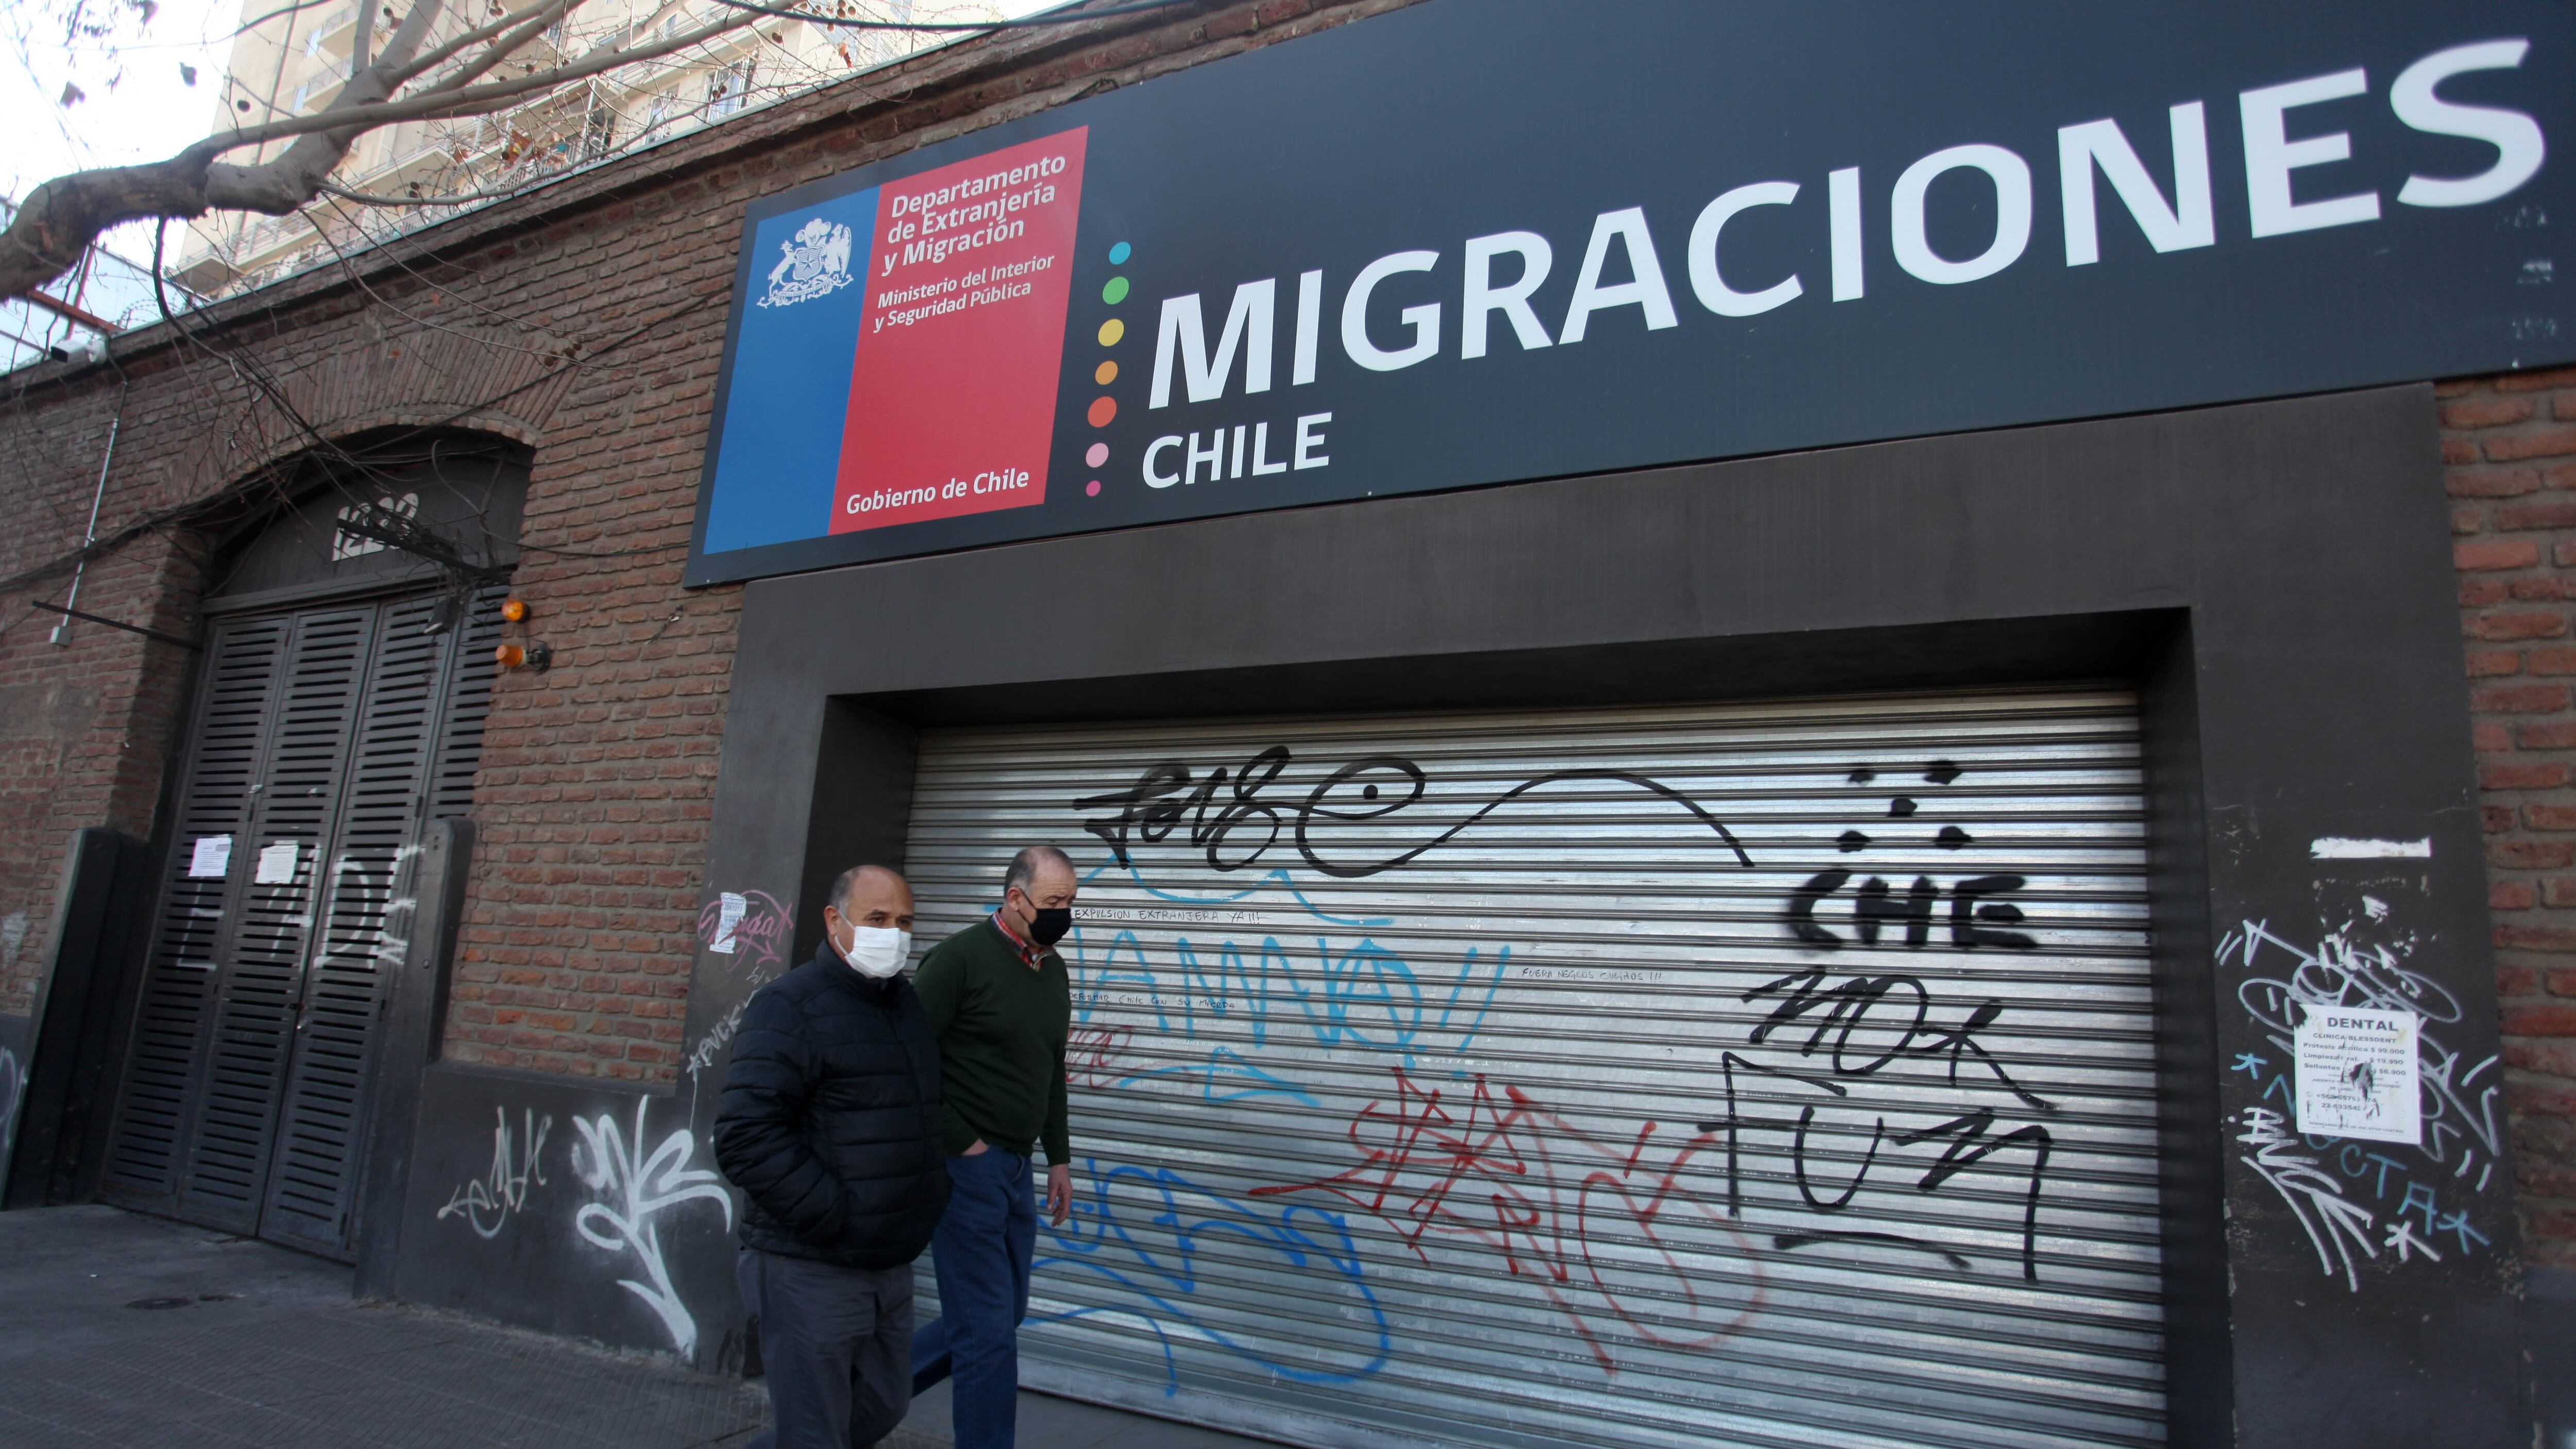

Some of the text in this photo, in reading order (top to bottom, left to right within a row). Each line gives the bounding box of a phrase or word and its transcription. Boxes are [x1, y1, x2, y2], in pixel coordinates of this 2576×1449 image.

[888, 182, 1055, 244] de Extranjería
[892, 156, 1065, 217] Departamento
[882, 218, 1024, 277] y Migración
[1149, 40, 2544, 410] MIGRACIONES
[873, 282, 1031, 333] y Seguridad Pública
[877, 255, 1055, 309] Ministerio del Interior
[1143, 412, 1333, 488] CHILE
[846, 468, 1029, 514] Gobierno de Chile
[1139, 910, 1219, 922] EXTRANJERA
[1557, 969, 1595, 979] NEGROS
[2327, 1017, 2399, 1031] DENTAL
